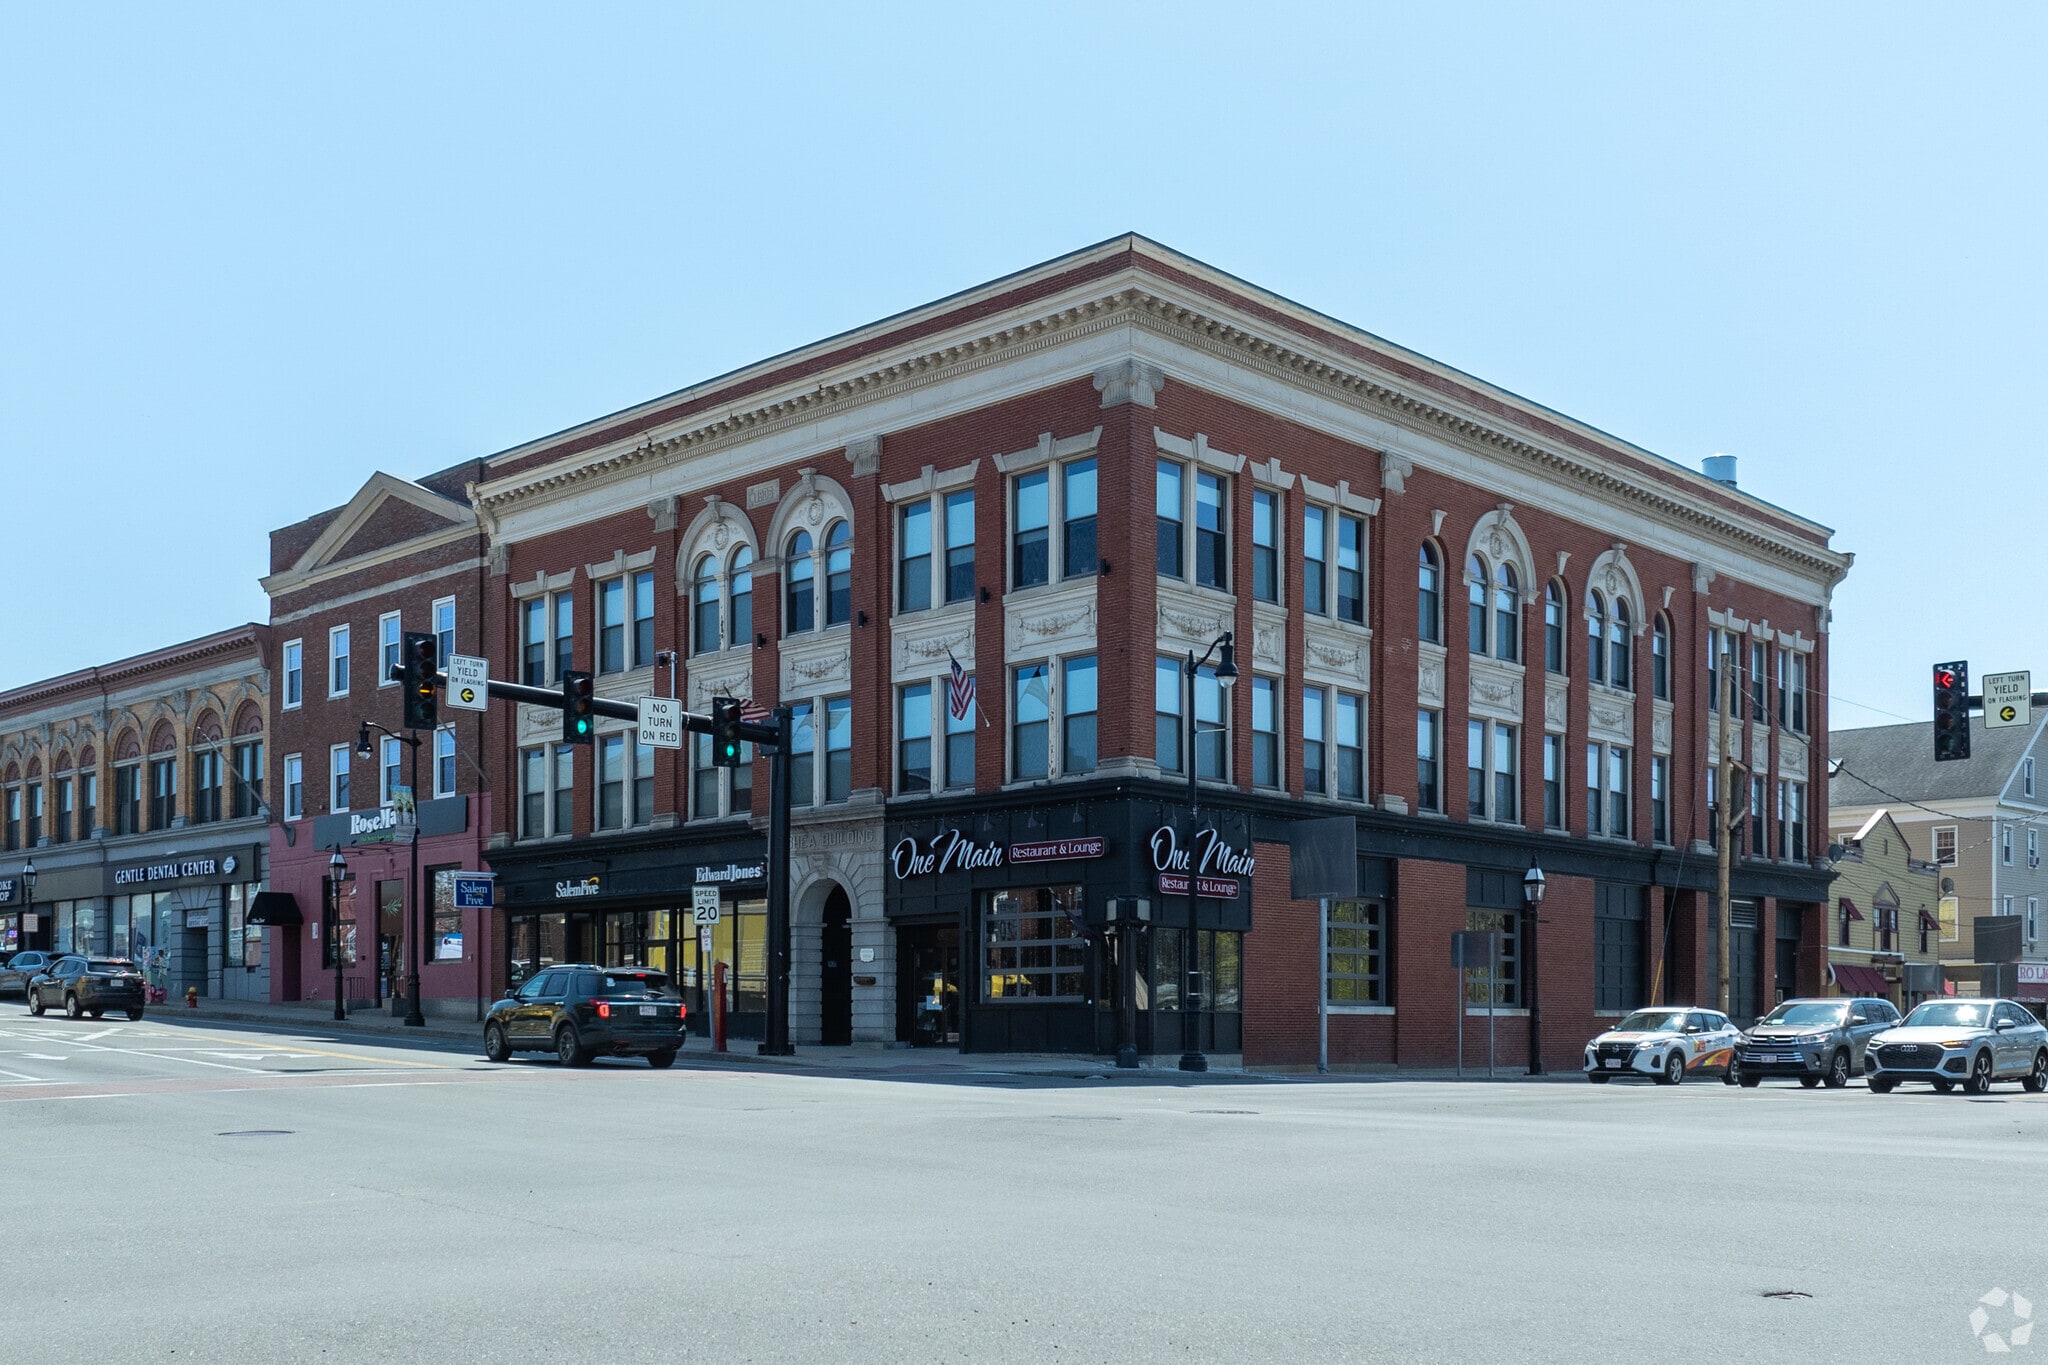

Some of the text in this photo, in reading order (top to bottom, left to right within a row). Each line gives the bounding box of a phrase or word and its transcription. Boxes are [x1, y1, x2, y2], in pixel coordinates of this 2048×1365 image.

[453, 658, 484, 668] LEFT TURN
[457, 666, 478, 677] YIELD
[461, 678, 485, 687] FLASHING
[1988, 674, 2025, 685] LEFT TURN
[1993, 683, 2019, 694] YIELD
[1987, 694, 2028, 705] ON FLASHING
[652, 703, 668, 714] NO
[647, 716, 673, 728] TURN
[642, 730, 677, 742] ON RED
[350, 807, 397, 835] RoseMa
[821, 829, 874, 847] BUILDING
[890, 828, 1003, 880] One Main
[1012, 841, 1102, 859] Restaurant & Lounge
[1195, 828, 1256, 877] Main
[115, 867, 145, 884] GENTLE
[147, 863, 179, 881] DENTAL
[181, 859, 216, 877] CENTER
[0, 880, 12, 891] OKE
[460, 881, 488, 894] Salem
[1161, 877, 1237, 895] Restaurt & Lounge
[0, 891, 10, 902] OP
[465, 893, 484, 906] Five
[696, 906, 718, 921] 20
[2020, 967, 2048, 980] RO LI
